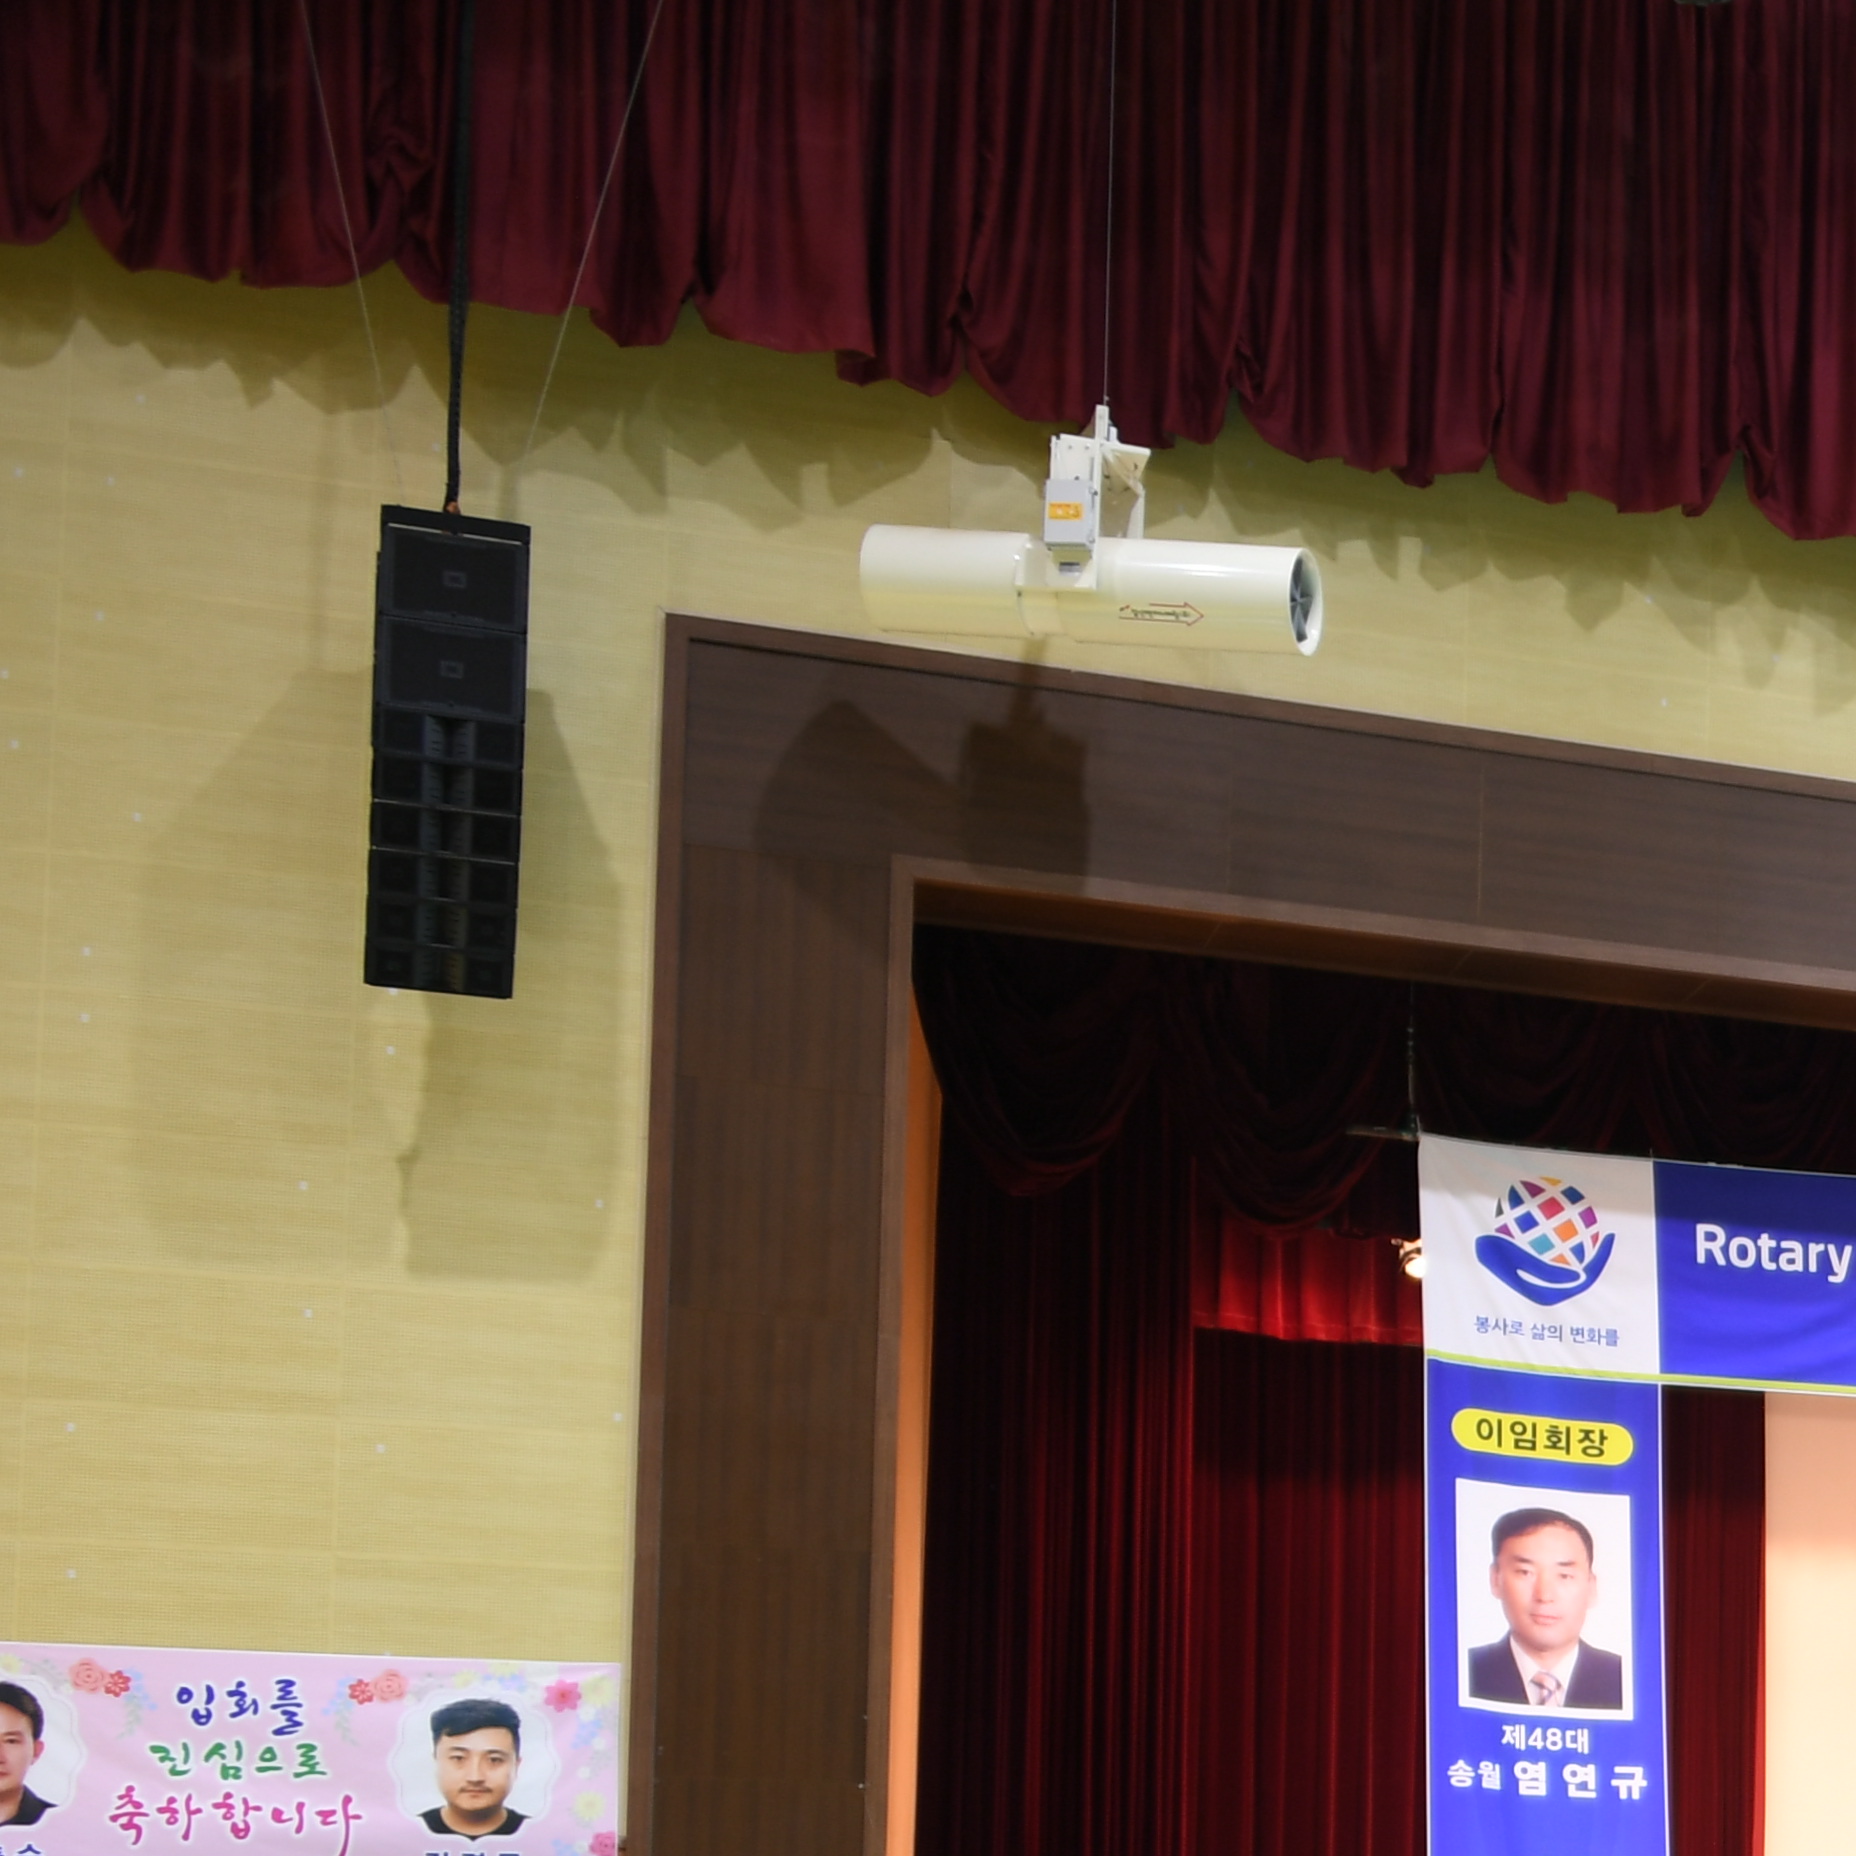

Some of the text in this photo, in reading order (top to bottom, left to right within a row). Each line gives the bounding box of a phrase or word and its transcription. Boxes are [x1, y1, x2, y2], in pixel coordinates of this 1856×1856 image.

[1695, 1223, 1852, 1284] Rotary
[1473, 1315, 1620, 1348] 봉사로 삶의 변화를
[1475, 1417, 1609, 1460] 이임회장
[175, 1678, 305, 1736] 입회를
[1501, 1723, 1589, 1754] 제48대
[148, 1740, 329, 1780] 진심으로
[1447, 1759, 1502, 1790] 송월
